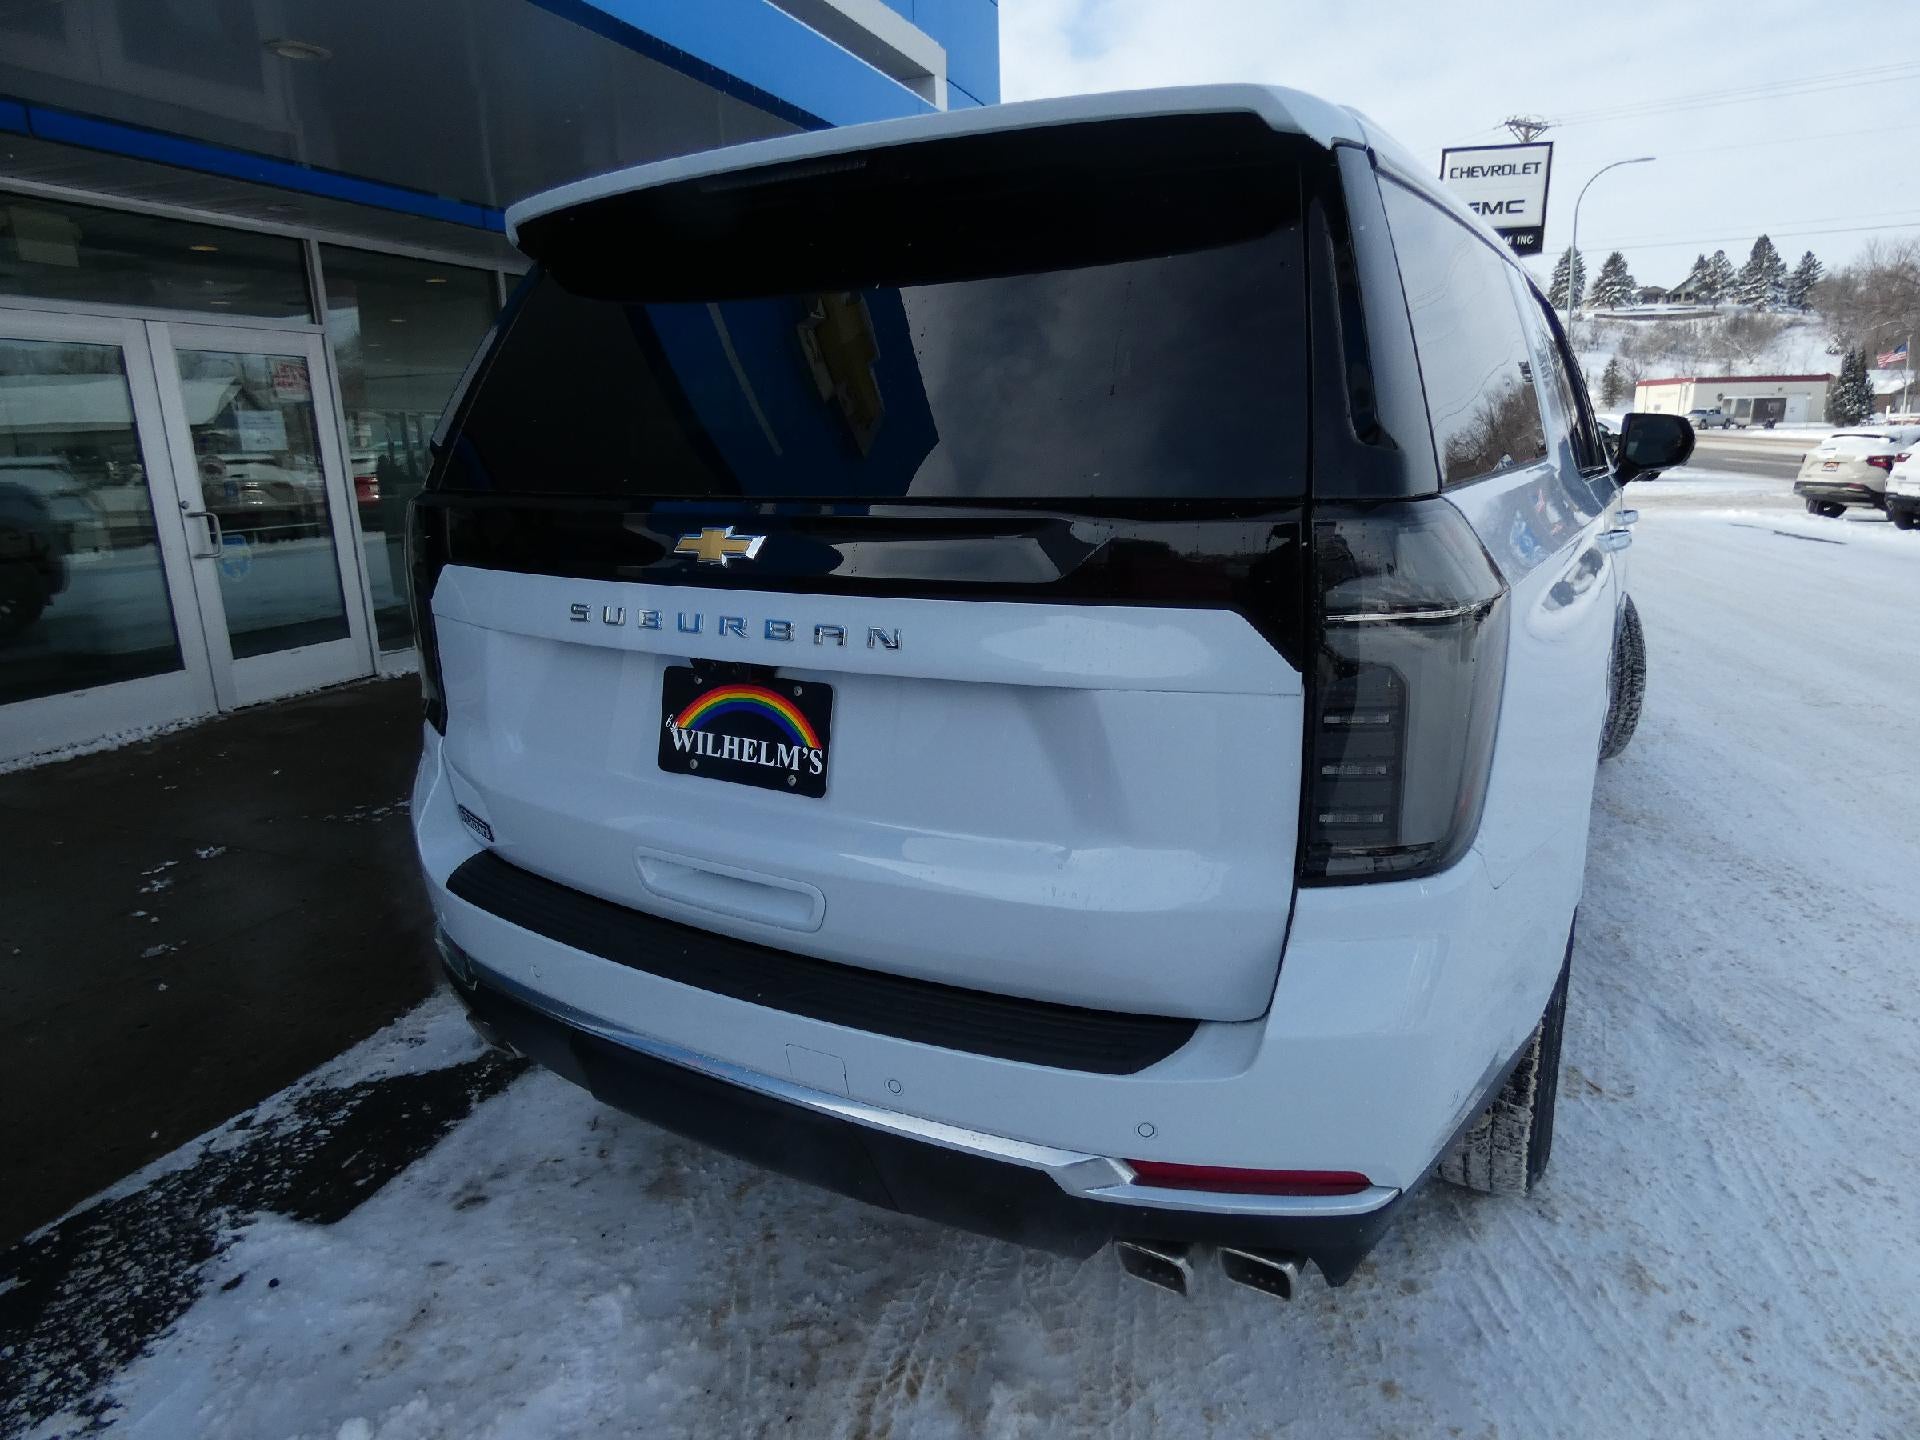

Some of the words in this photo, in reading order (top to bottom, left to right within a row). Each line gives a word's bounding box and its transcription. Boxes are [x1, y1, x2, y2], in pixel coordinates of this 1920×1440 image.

[1450, 162, 1542, 179] CHEVROLET
[1517, 235, 1535, 245] INC
[570, 602, 902, 652] SUBURBAN
[665, 713, 680, 733] by
[670, 727, 823, 775] WILHELM'S
